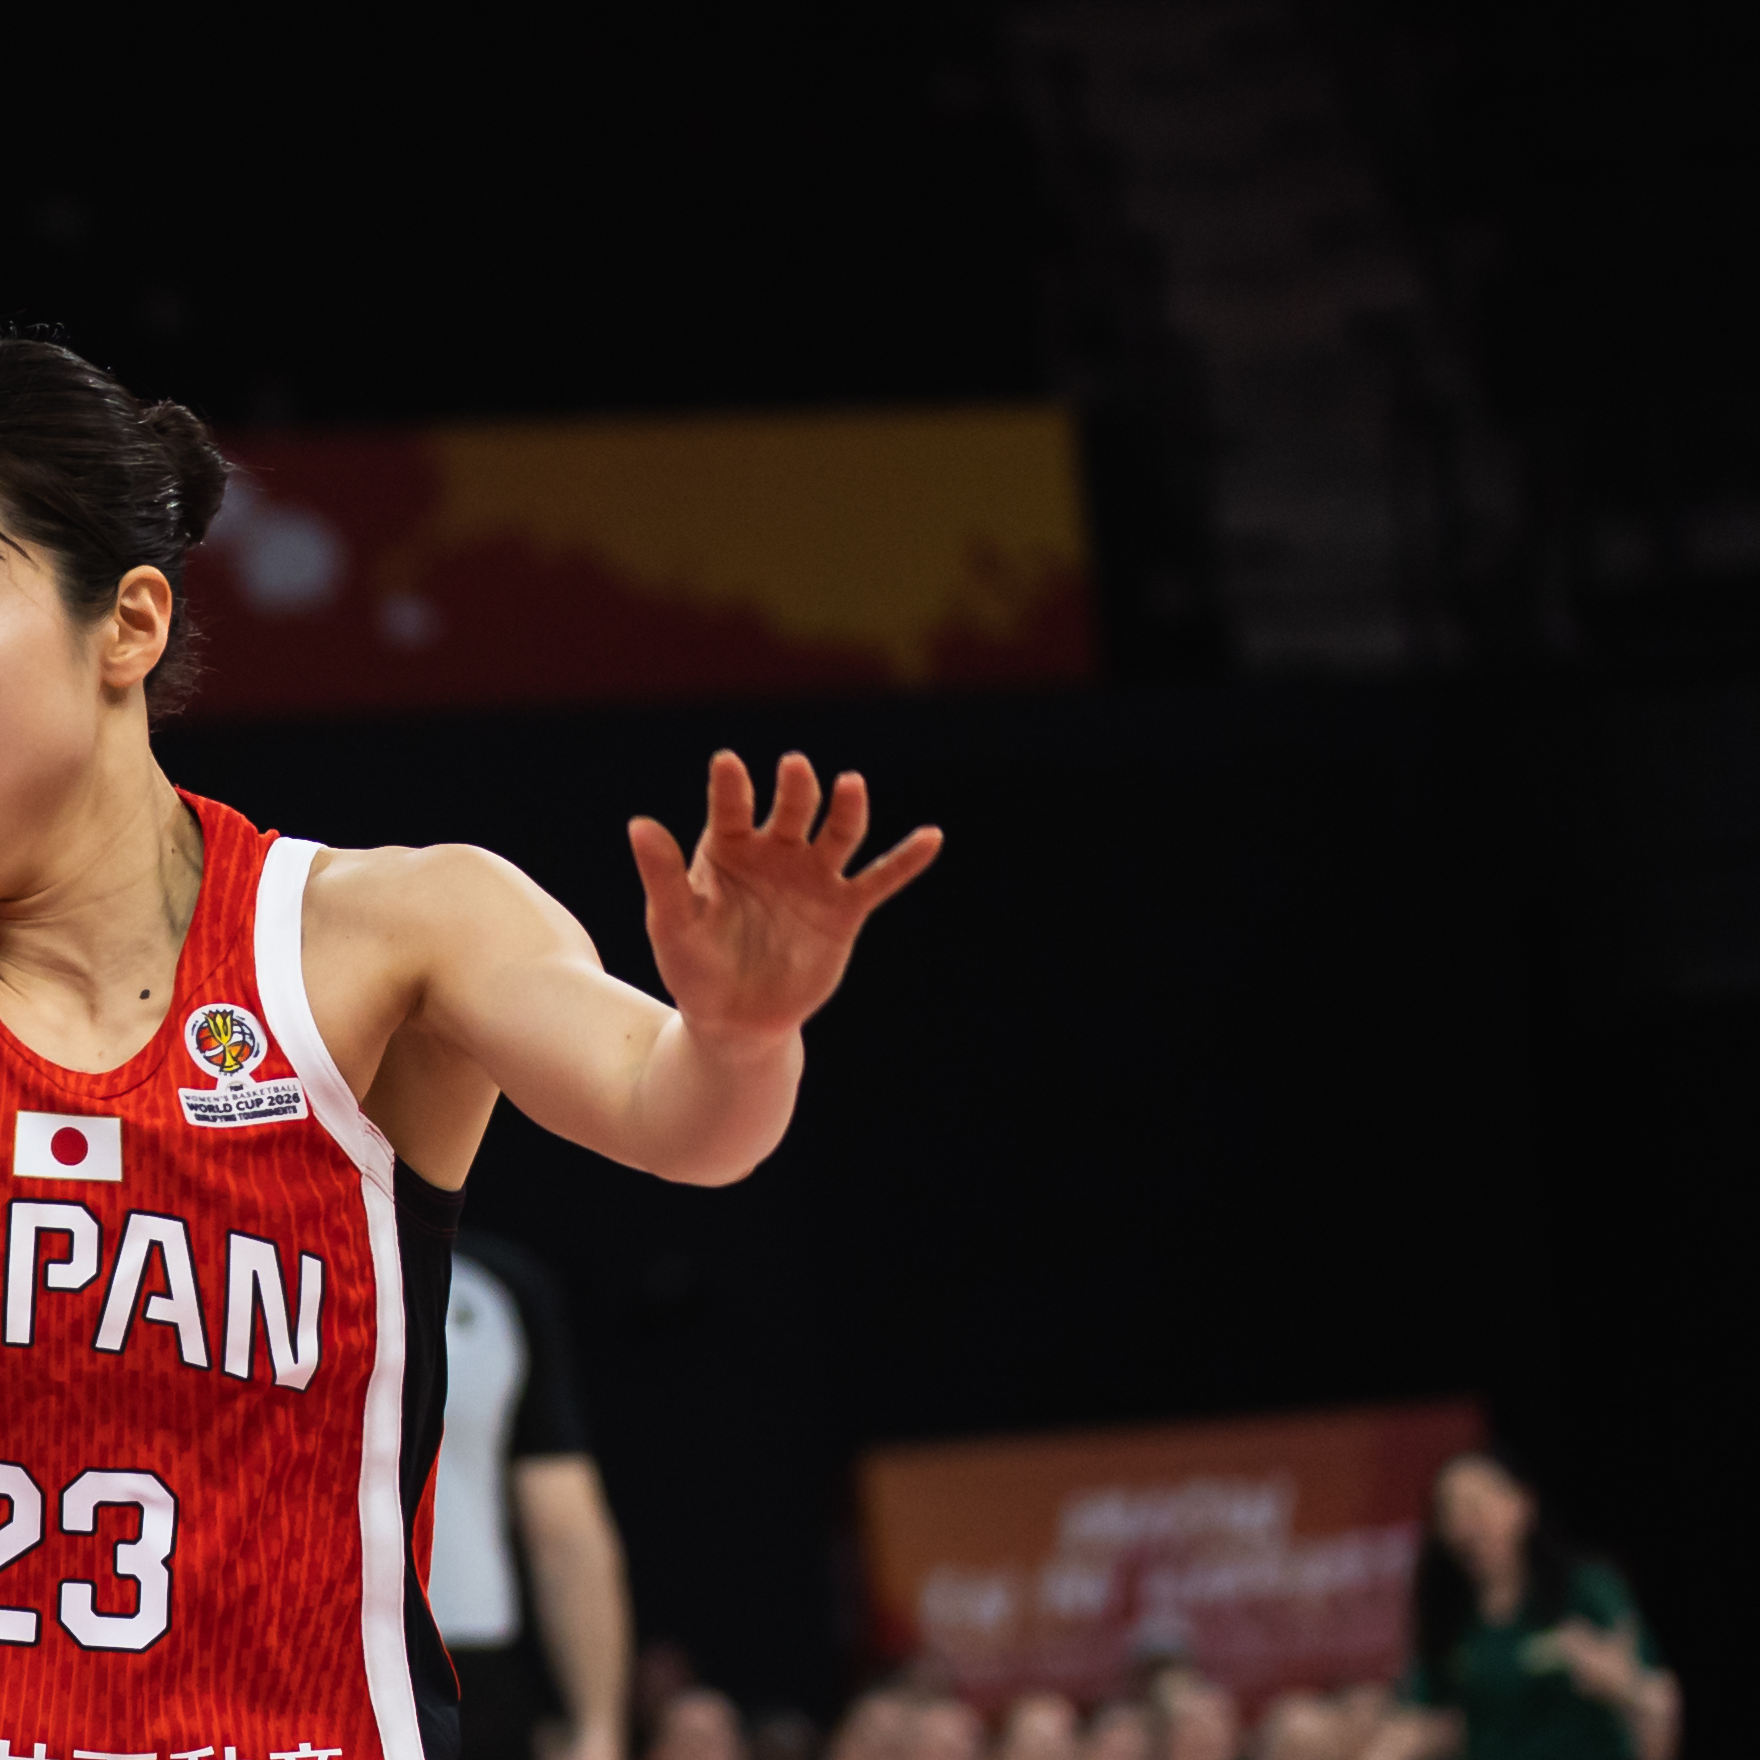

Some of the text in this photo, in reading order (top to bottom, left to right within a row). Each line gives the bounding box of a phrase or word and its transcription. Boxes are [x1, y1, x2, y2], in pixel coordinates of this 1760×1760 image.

[186, 1093, 300, 1113] WORLD CUP 2026
